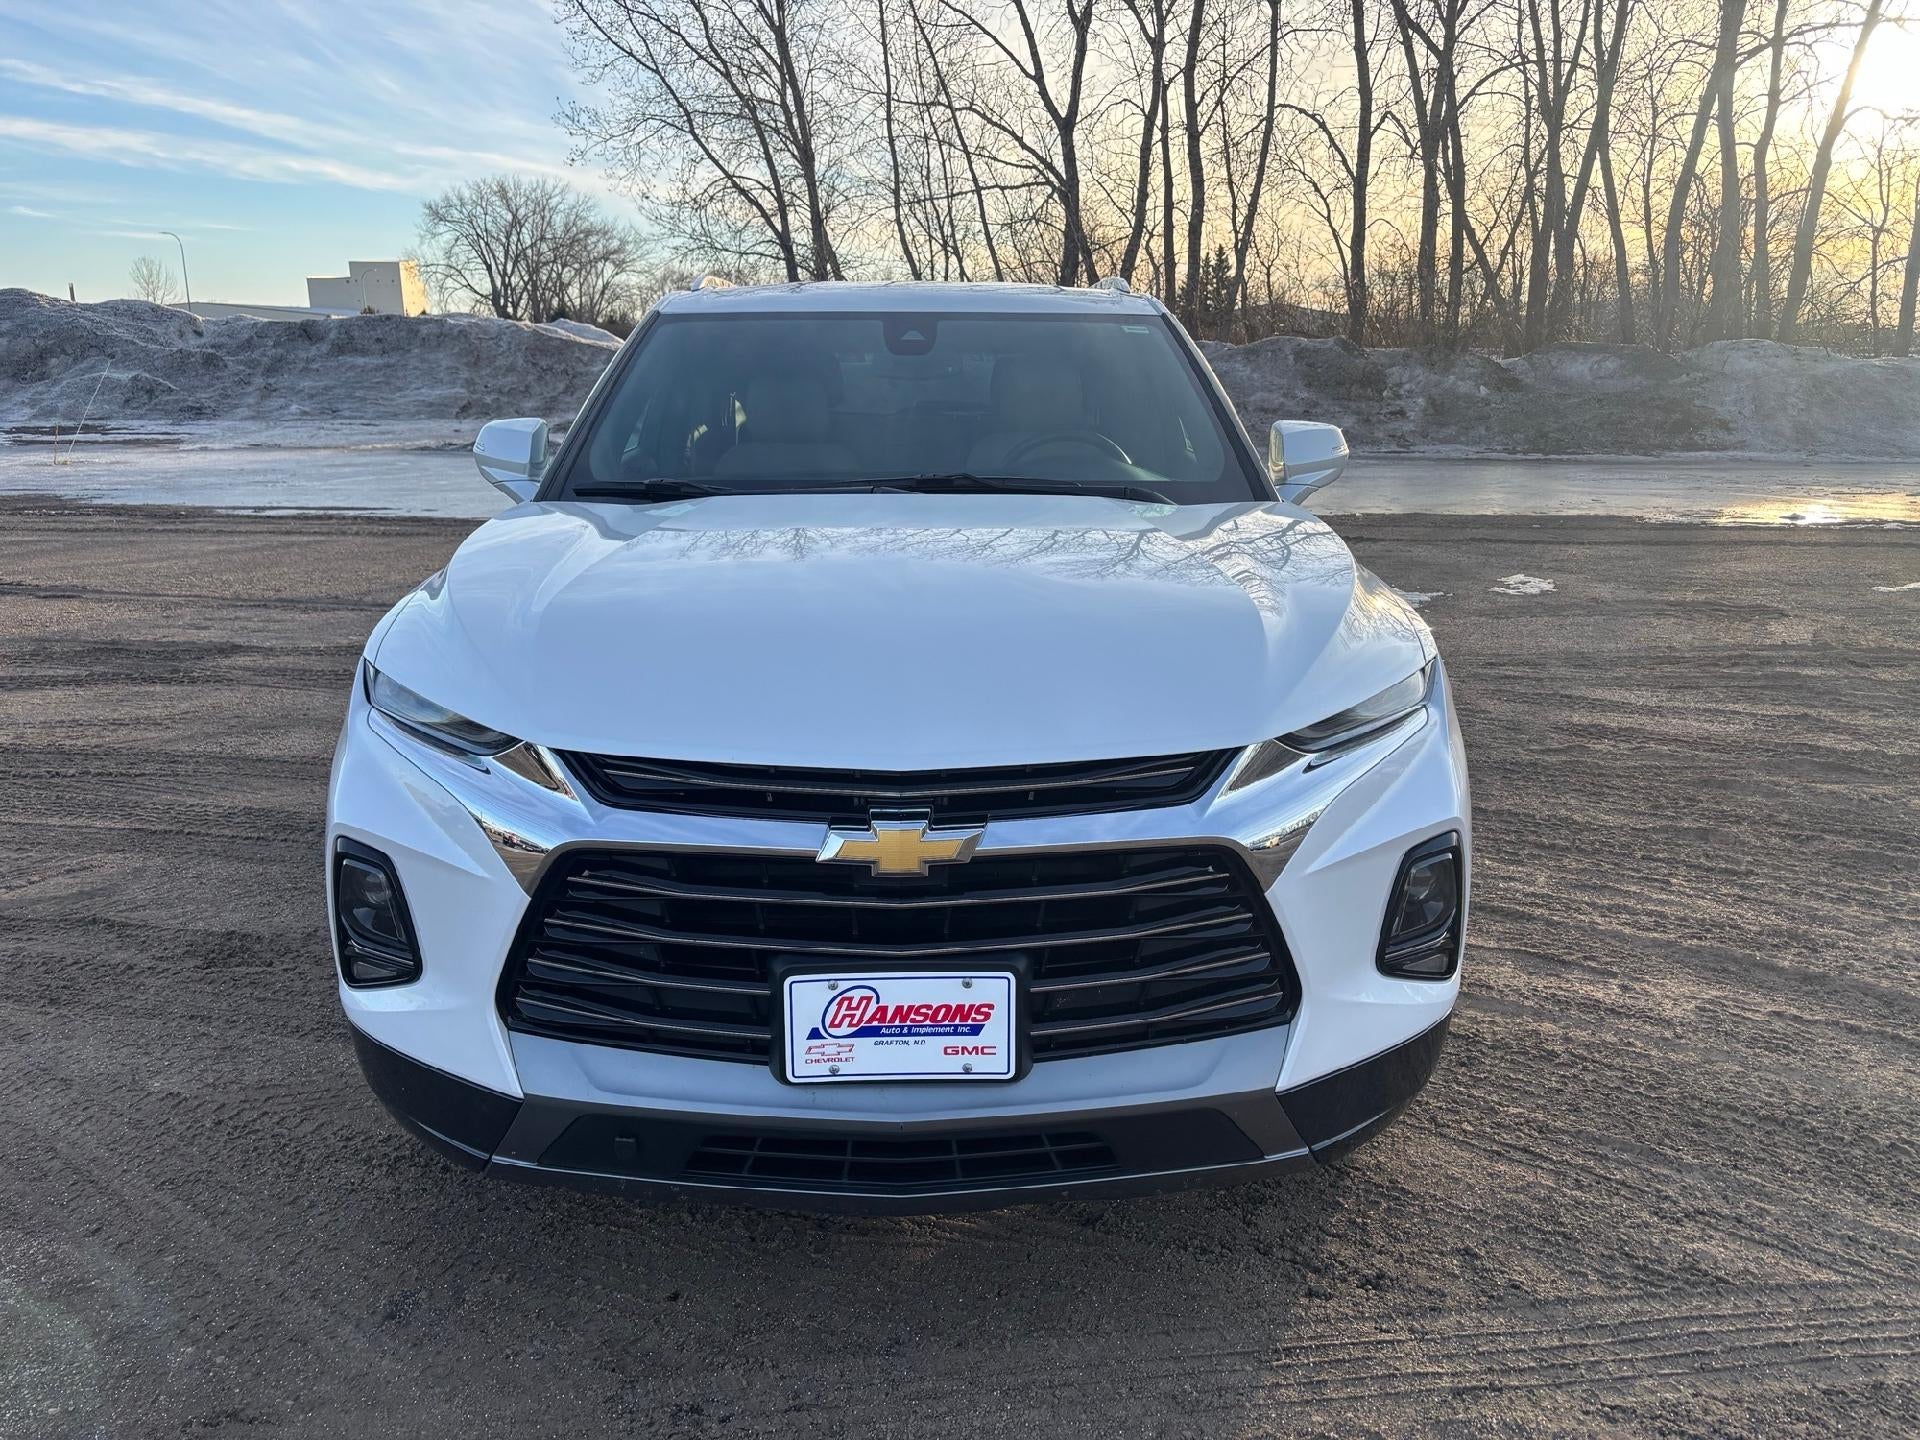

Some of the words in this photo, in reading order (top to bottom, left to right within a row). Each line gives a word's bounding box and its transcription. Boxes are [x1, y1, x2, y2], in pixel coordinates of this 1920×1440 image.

[828, 995, 995, 1029] HANSONS
[880, 1026, 900, 1034] Auto
[911, 1025, 955, 1034] Implement
[957, 1025, 971, 1033] Inc.
[943, 1045, 997, 1056] GMC
[805, 1056, 855, 1064] CHEVROLET
